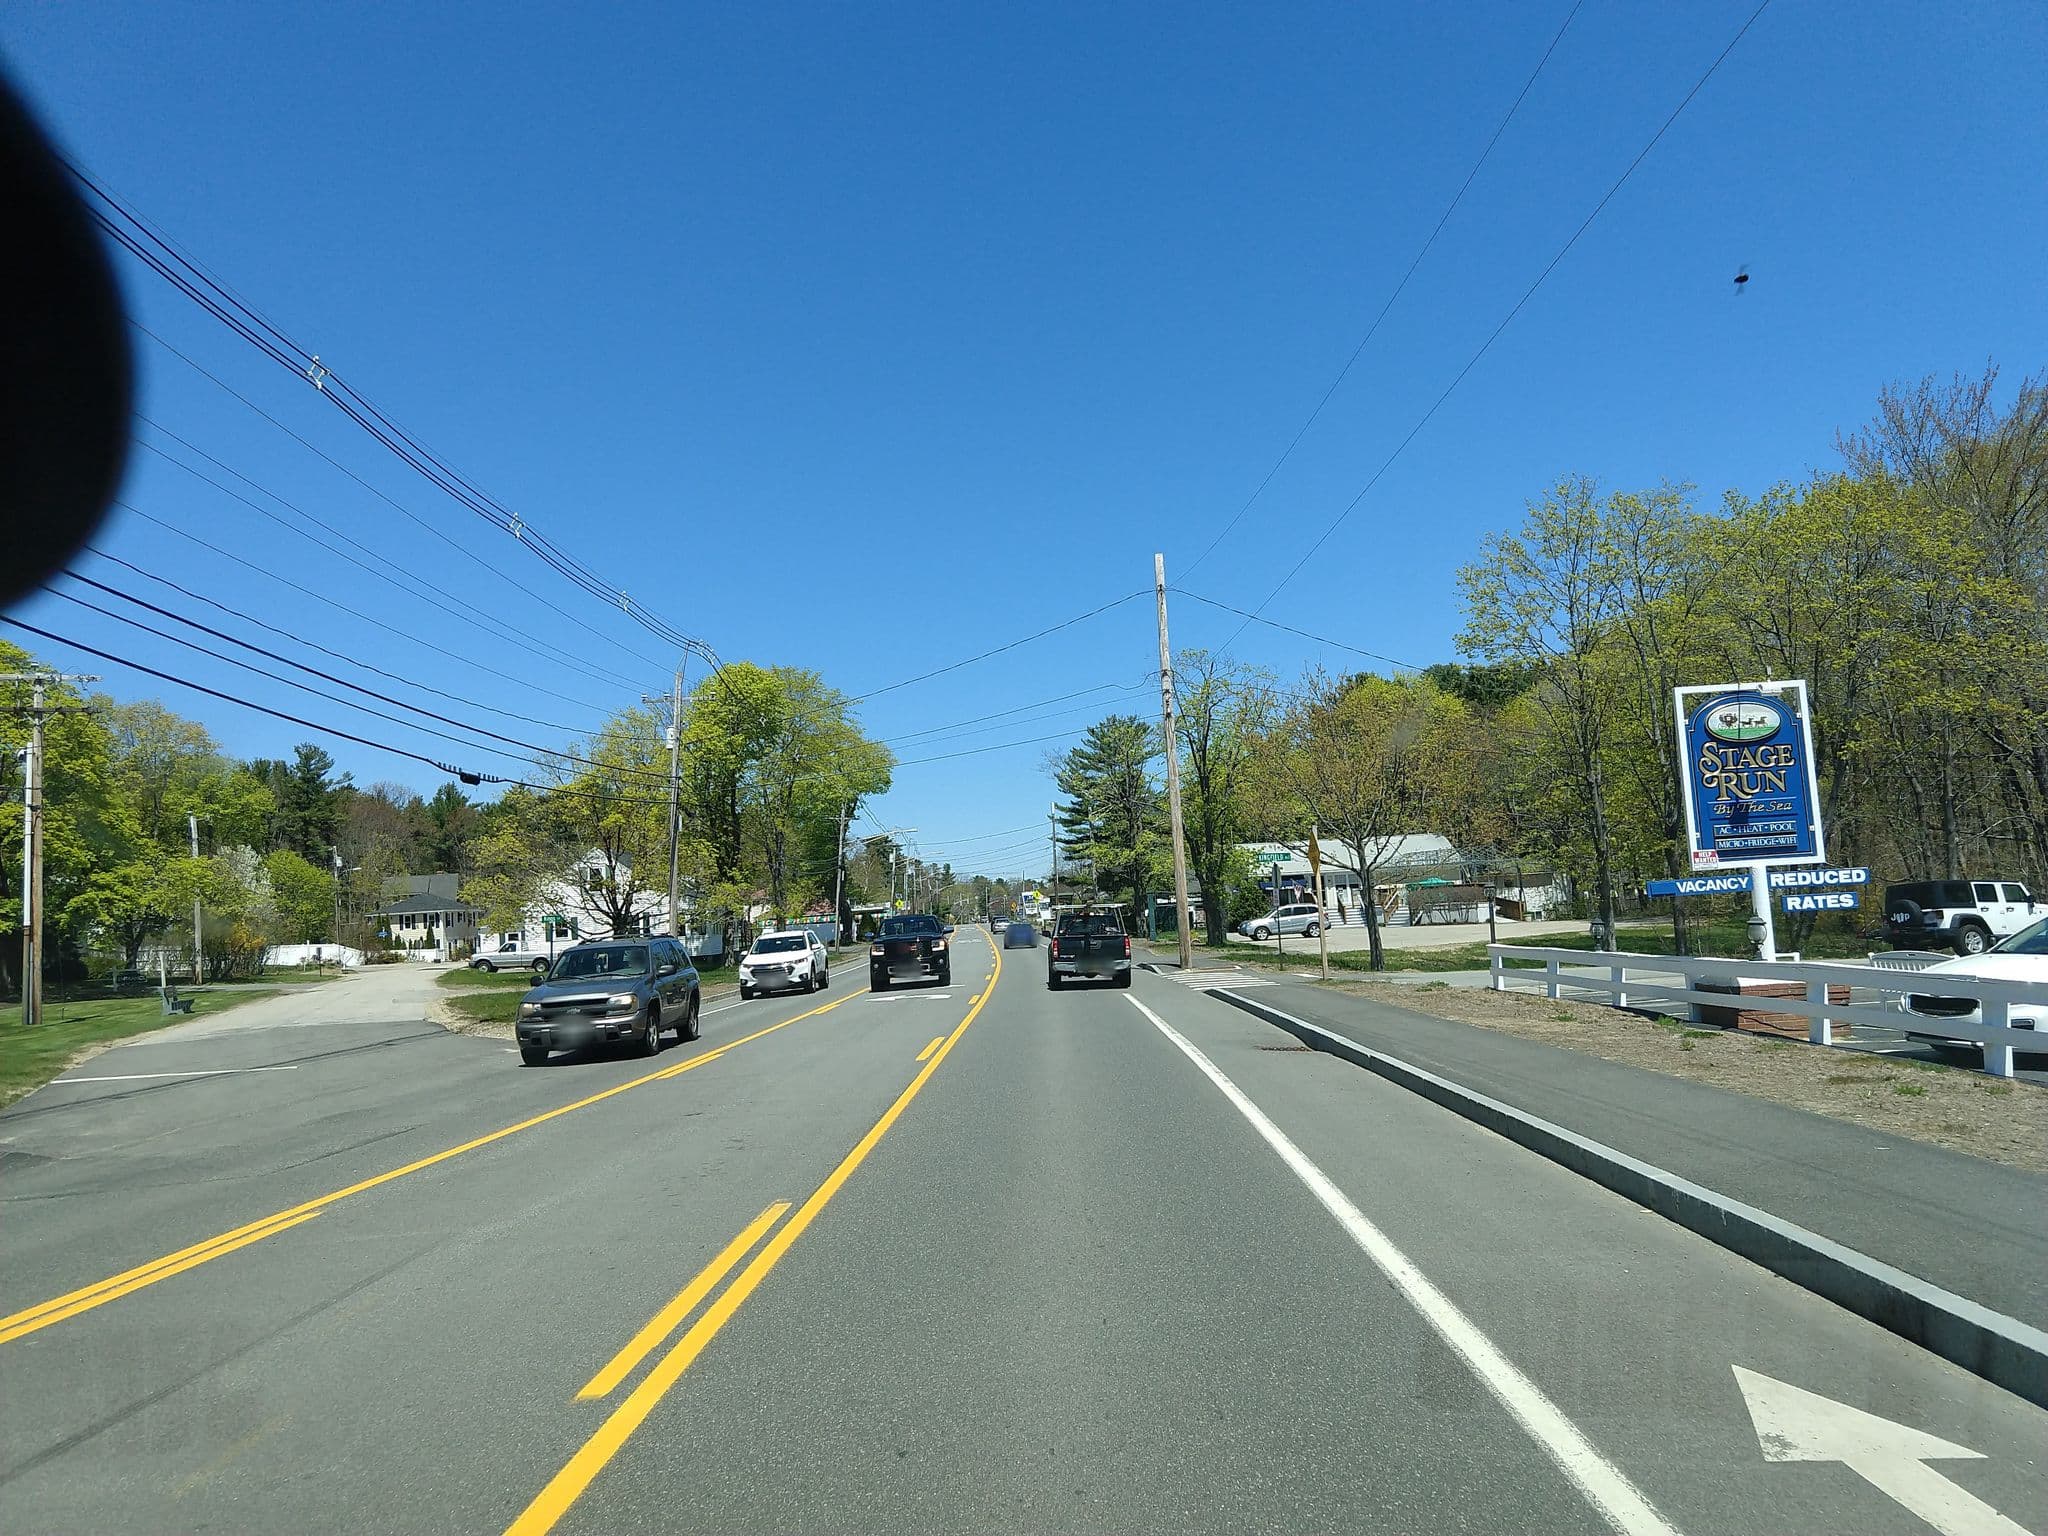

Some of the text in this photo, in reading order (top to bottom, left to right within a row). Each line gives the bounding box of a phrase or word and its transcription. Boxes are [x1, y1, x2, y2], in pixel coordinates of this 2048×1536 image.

[1698, 742, 1795, 775] STAGE
[1703, 770, 1787, 801] RUN
[1713, 800, 1793, 818] By The Sea
[1719, 822, 1794, 835] AC HEAT POOL
[1676, 877, 1750, 893] VACANCY
[1770, 869, 1866, 886] REDUCED
[1787, 894, 1854, 911] RATES
